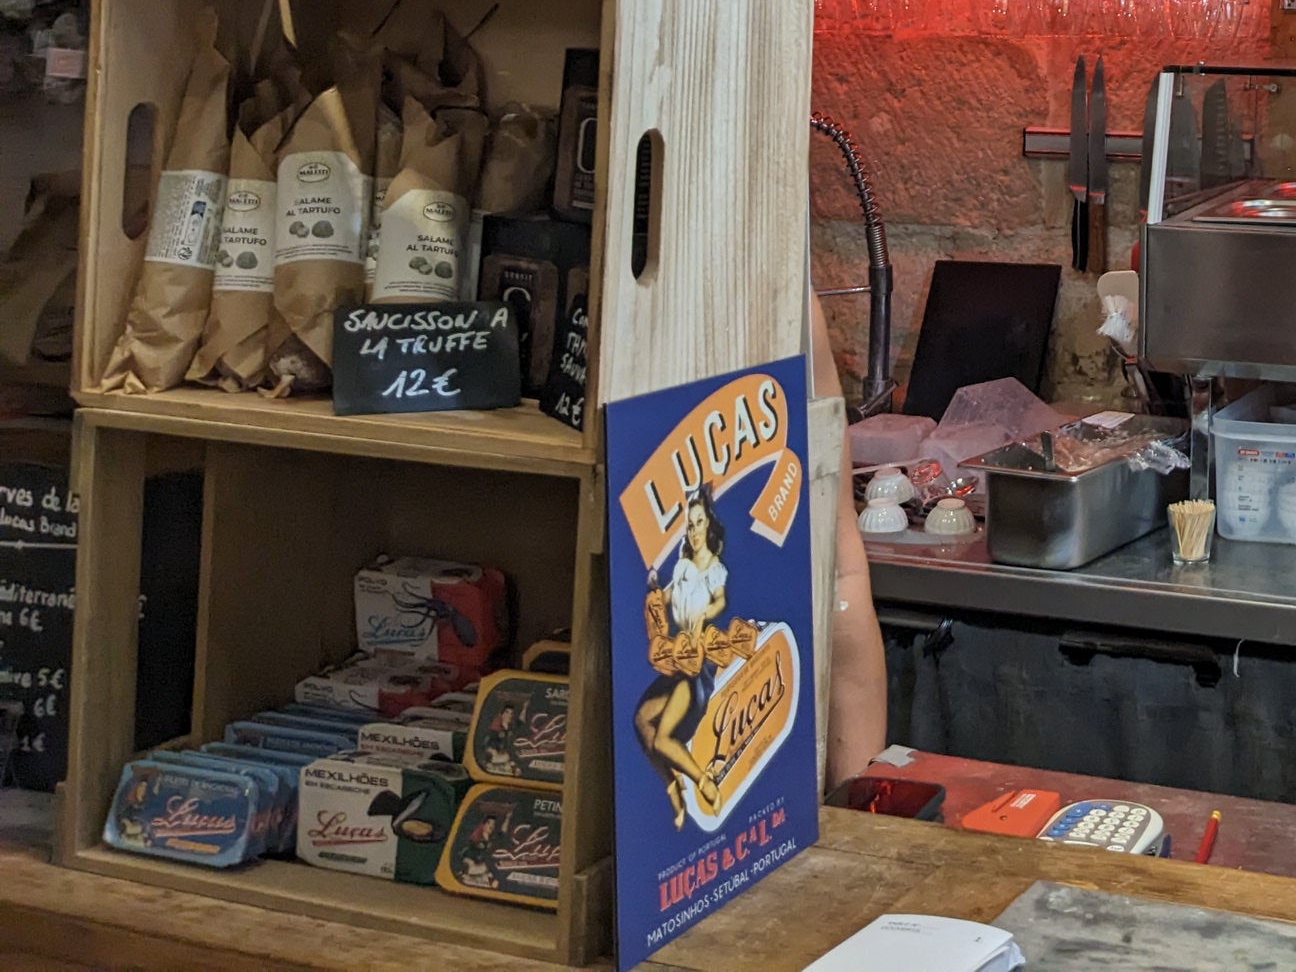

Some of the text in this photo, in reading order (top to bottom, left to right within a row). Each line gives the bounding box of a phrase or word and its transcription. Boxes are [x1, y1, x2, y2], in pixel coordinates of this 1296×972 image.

[294, 196, 332, 205] SALAME
[298, 206, 340, 216] TARTUFO
[344, 307, 508, 332] SAUCISSON A
[360, 331, 491, 360] LA TRUFFE
[382, 368, 460, 399] 12€
[643, 379, 779, 534] LUCAS
[767, 461, 797, 522] BRAND
[712, 650, 786, 760] Lucas
[361, 731, 440, 751] MEXILHÕES
[304, 768, 389, 788] MEXILHÕES
[748, 805, 775, 824] PACKED
[657, 858, 687, 881] PRODUCT
[698, 834, 727, 855] PORTUGAL
[659, 856, 718, 912] LUCAS
